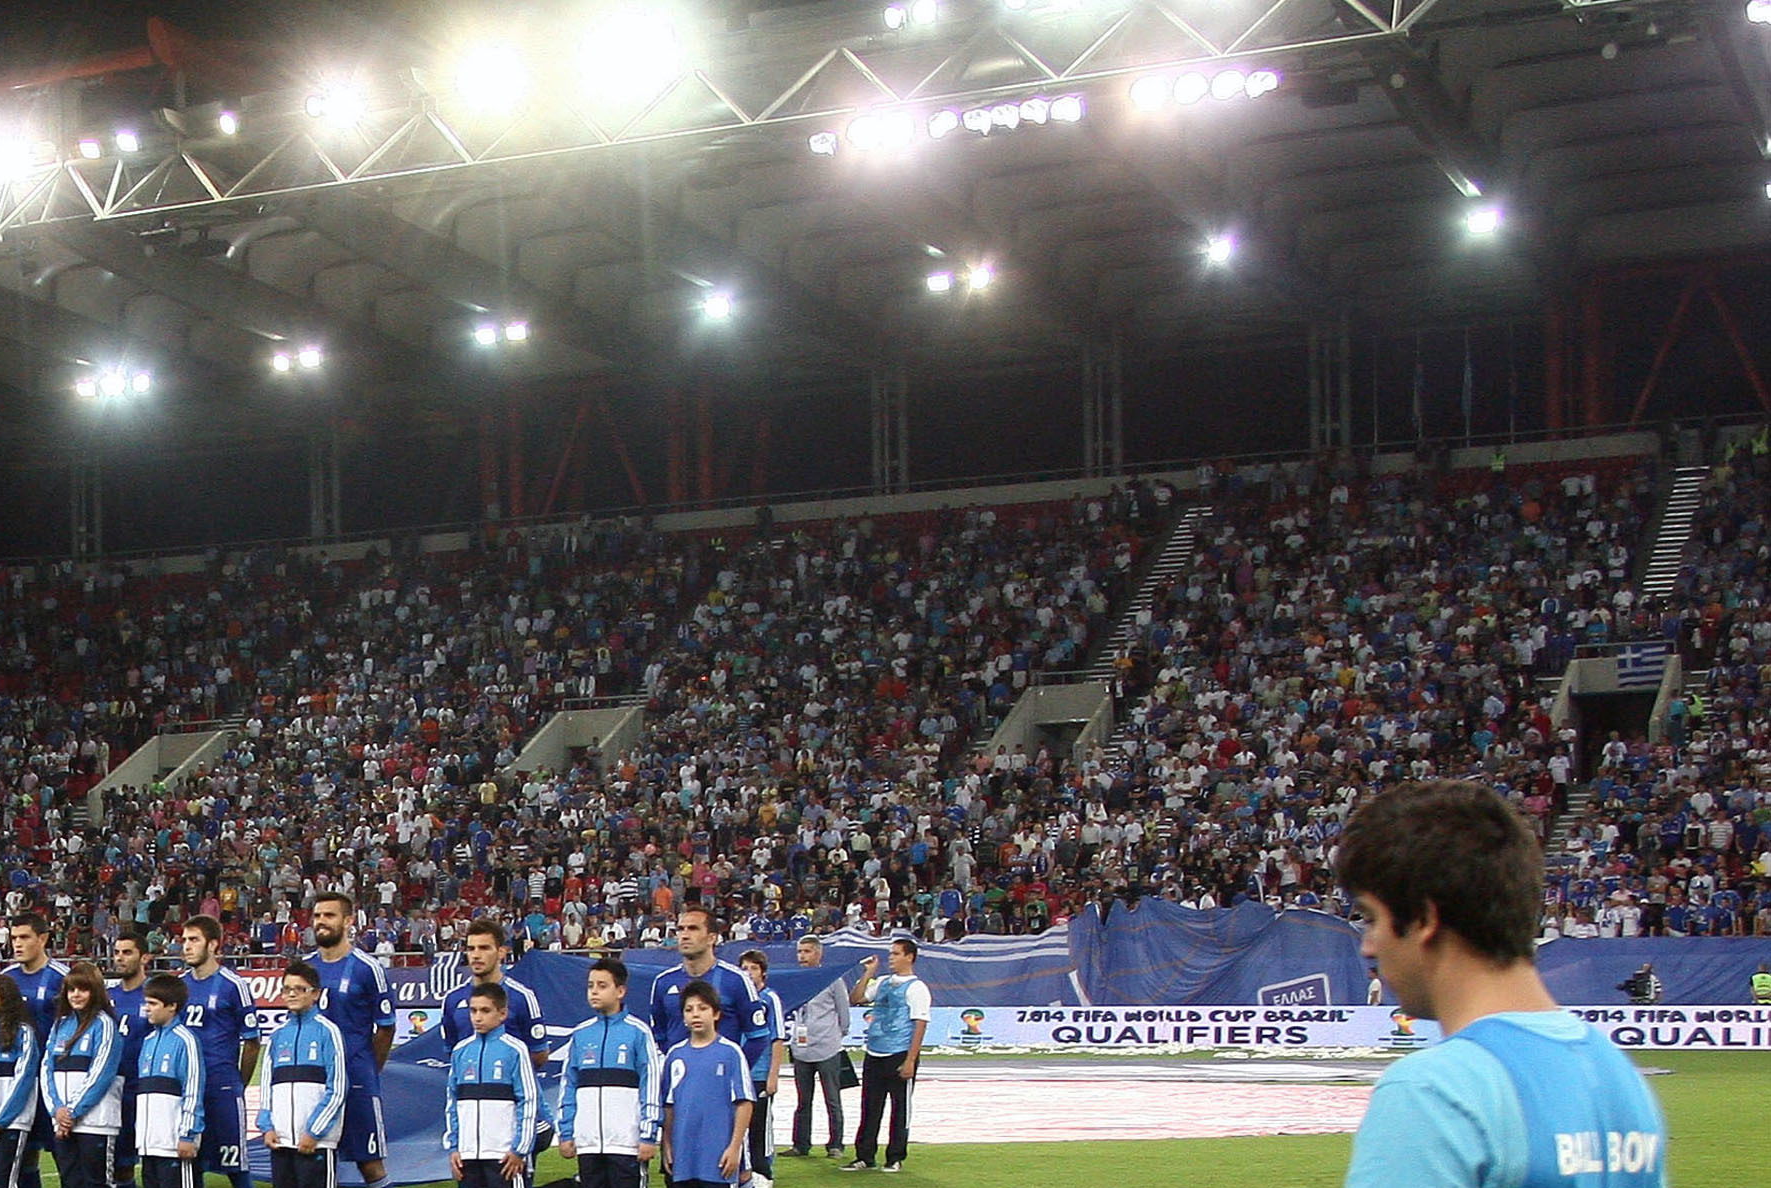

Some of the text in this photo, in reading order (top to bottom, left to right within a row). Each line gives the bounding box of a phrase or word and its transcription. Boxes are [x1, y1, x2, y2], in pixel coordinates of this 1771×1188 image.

[318, 987, 329, 1012] 6
[185, 1004, 204, 1027] 22
[1072, 1010, 1118, 1022] FIFA
[1209, 1010, 1257, 1022] CUP
[1634, 1009, 1687, 1023] FIFA
[1694, 1009, 1771, 1023] WORL
[1051, 1025, 1309, 1045] QUALIFIERS
[1610, 1026, 1771, 1047] QUALI
[367, 1131, 377, 1154] 6
[1606, 1131, 1659, 1173] BOY
[219, 1144, 240, 1167] 22
